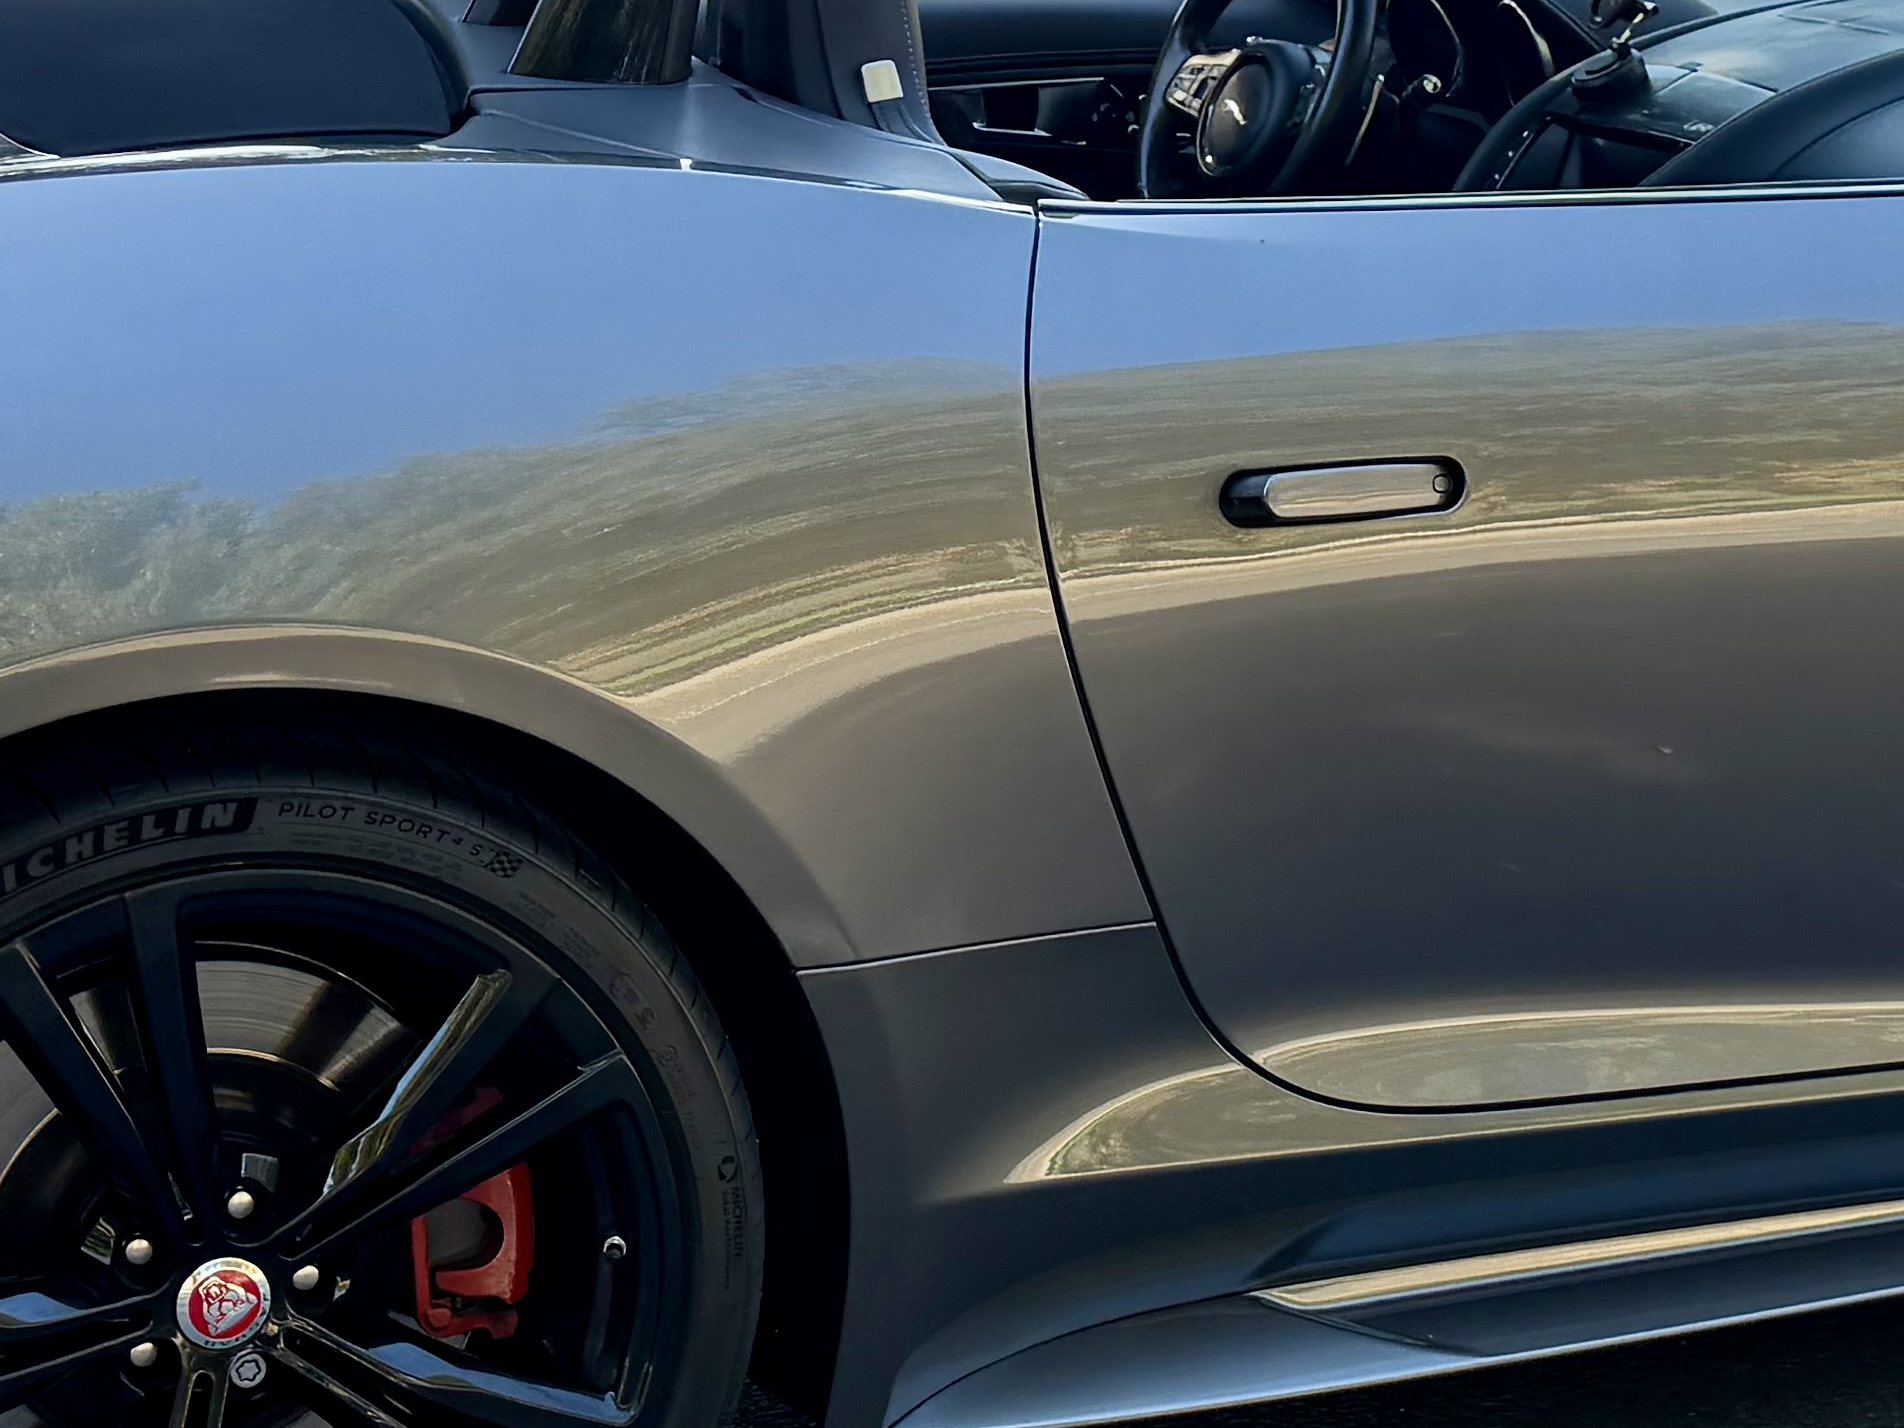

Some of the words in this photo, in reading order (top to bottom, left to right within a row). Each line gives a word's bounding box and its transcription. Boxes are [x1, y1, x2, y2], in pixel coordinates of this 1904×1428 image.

[278, 802, 355, 821] PILOT
[363, 811, 451, 844] SPORT
[468, 843, 484, 857] S
[730, 1185, 744, 1258] MICHELIN
